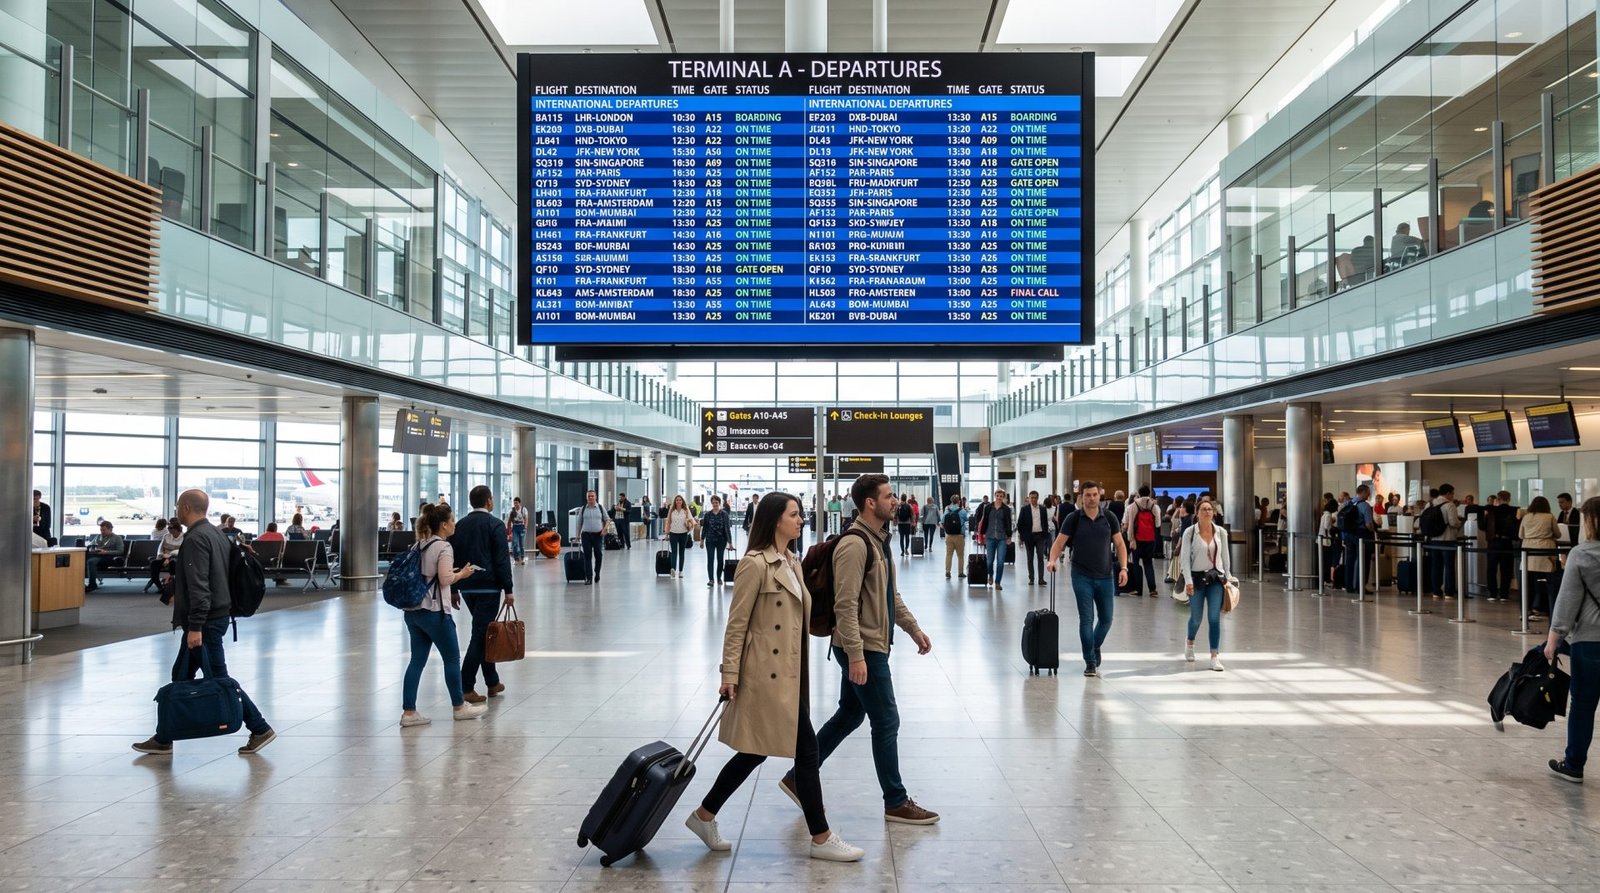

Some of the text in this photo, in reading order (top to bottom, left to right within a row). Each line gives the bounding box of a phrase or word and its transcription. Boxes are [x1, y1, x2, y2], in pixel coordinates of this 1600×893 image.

[668, 61, 773, 78] TERMINAL
[779, 61, 792, 78] A
[812, 60, 942, 78] DEPARTURES
[536, 86, 770, 94] FLIGHT DESTINATION TIME GATE STATUS
[809, 85, 1044, 94] FLIGHT DESTINATION TIME GATE STATUS
[536, 100, 678, 108] INTERNATIONAL DEPARTURES
[809, 100, 952, 108] INTERNATIONAL DEPARTURES
[536, 114, 562, 122] BA115
[576, 114, 633, 122] LHR-LONDON
[673, 114, 695, 122] 10:30
[736, 114, 781, 122] BOARDING
[849, 113, 1056, 121] DXB-DUBAI 13:30 A15 BOARDING
[576, 125, 623, 133] DXB-DUBAI
[849, 125, 997, 133] HND-TOKYO 13:20 A22
[576, 137, 628, 145] HND-TOKYO
[673, 137, 695, 145] 12:30
[736, 137, 749, 145] ON
[890, 136, 913, 144] YORK
[1011, 136, 1024, 144] ON
[1026, 136, 1047, 144] TIME
[536, 148, 640, 156] DL42 JFK-NEW YORK
[849, 148, 888, 156] JFK-NEW
[890, 148, 913, 156] YORK
[948, 148, 970, 156] 13:30
[576, 159, 771, 167] SIN-SINGAPORE ON TIME
[849, 159, 918, 167] SIN-SINGAPORE
[948, 159, 971, 167] 13:40
[981, 159, 997, 167] A18
[536, 169, 722, 177] AF152 PAR-PARIS A25
[809, 169, 836, 177] AF152
[849, 169, 894, 177] PAR-PARIS
[948, 169, 970, 177] 13:30
[981, 169, 997, 177] A25
[1011, 169, 1033, 177] GATE
[576, 179, 630, 187] SYD-SYDNEY
[1011, 179, 1058, 187] GATE OPEN
[576, 189, 695, 197] FRA-FRANKFURT 12:30
[948, 189, 997, 197] 12:30 A25
[576, 199, 771, 207] FRA-AMSTERDAM 12:20 A15 ON TIME
[849, 199, 1046, 207] SIN-SINGAPORE 12:30 A25 ON TIME
[576, 209, 722, 217] BOM-MUMBAI 12:30 A22
[849, 209, 1058, 217] PAR-PARIS 13:30 A22 GATE OPEN
[673, 219, 722, 227] 13:30 A25
[948, 219, 970, 227] 13:30
[576, 231, 647, 239] FRA-FRANKFURT
[948, 231, 970, 239] 13:30
[948, 242, 997, 250] 13:30 A25
[706, 254, 722, 262] A25
[948, 254, 970, 262] 13:30
[536, 266, 558, 274] QF10
[576, 266, 630, 274] SYD-SYDNEY
[809, 266, 831, 274] QF10
[1011, 265, 1024, 273] ON
[536, 277, 556, 285] K101
[576, 277, 647, 285] FRA-FRANKFURT
[673, 277, 695, 285] 13:30
[981, 277, 998, 285] A25
[575, 289, 722, 297] AMS-AMSTERDAM A25
[981, 289, 1059, 297] A25 FINAL CALL
[673, 301, 695, 309] 13:30
[576, 312, 636, 320] BOM-MUMBAI
[706, 312, 722, 320] A25
[736, 312, 749, 320] ON
[750, 312, 772, 320] TIME
[981, 312, 997, 320] A25
[1011, 312, 1024, 320] ON
[1026, 312, 1047, 320] TIME
[890, 412, 923, 421] Lounges
